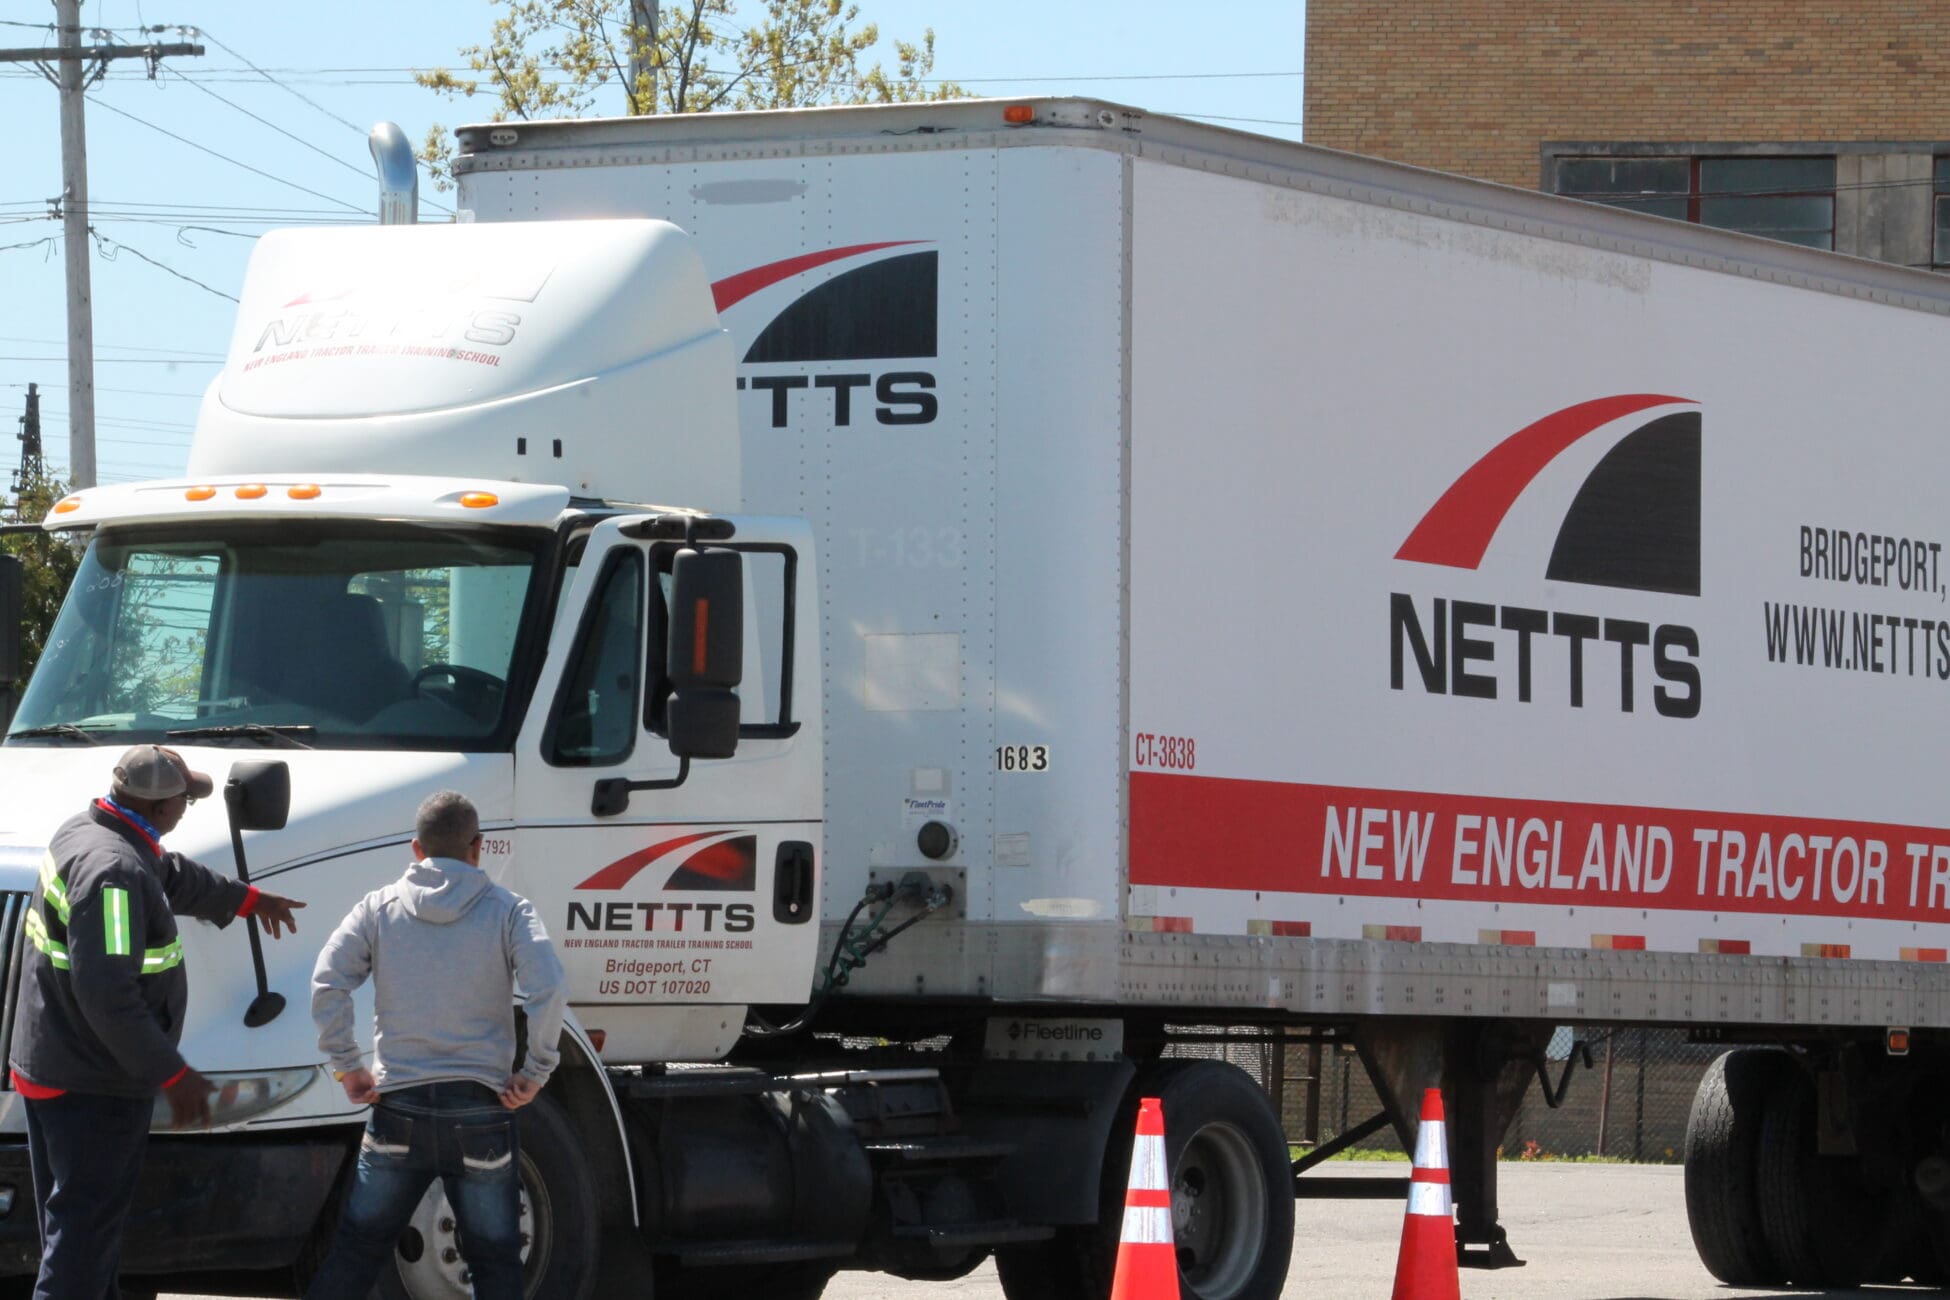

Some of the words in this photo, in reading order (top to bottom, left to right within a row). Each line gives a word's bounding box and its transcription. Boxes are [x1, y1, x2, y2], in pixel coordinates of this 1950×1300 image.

[253, 310, 522, 353] NES
[310, 345, 355, 358] TRACTOR
[356, 344, 399, 355] TRAER
[456, 349, 502, 367] SCHOOL
[1800, 525, 1946, 603] BRIDGEPORT,
[1390, 592, 1702, 719] NETTTS
[1763, 601, 1950, 681] WWW.NETTTS
[996, 745, 1048, 771] 1683
[1135, 732, 1196, 770] CT-3838
[1320, 805, 1435, 883] NEW
[1450, 813, 1674, 894] ENGLAND
[1693, 828, 1889, 905] TRACTOR
[566, 902, 756, 933] NETTTS
[564, 939, 582, 948] NEW
[584, 939, 619, 949] ENGLAND
[621, 939, 654, 949] TRACTOR
[656, 939, 686, 949] TRAILER
[688, 939, 724, 949] TRAINING
[726, 940, 753, 949] SCHOOL
[606, 959, 687, 976] Bridgeport,
[691, 959, 712, 973] CT
[599, 981, 620, 994] US
[624, 981, 657, 994] DOT
[662, 981, 711, 995] 107020
[1023, 1023, 1103, 1041] Fleetline
